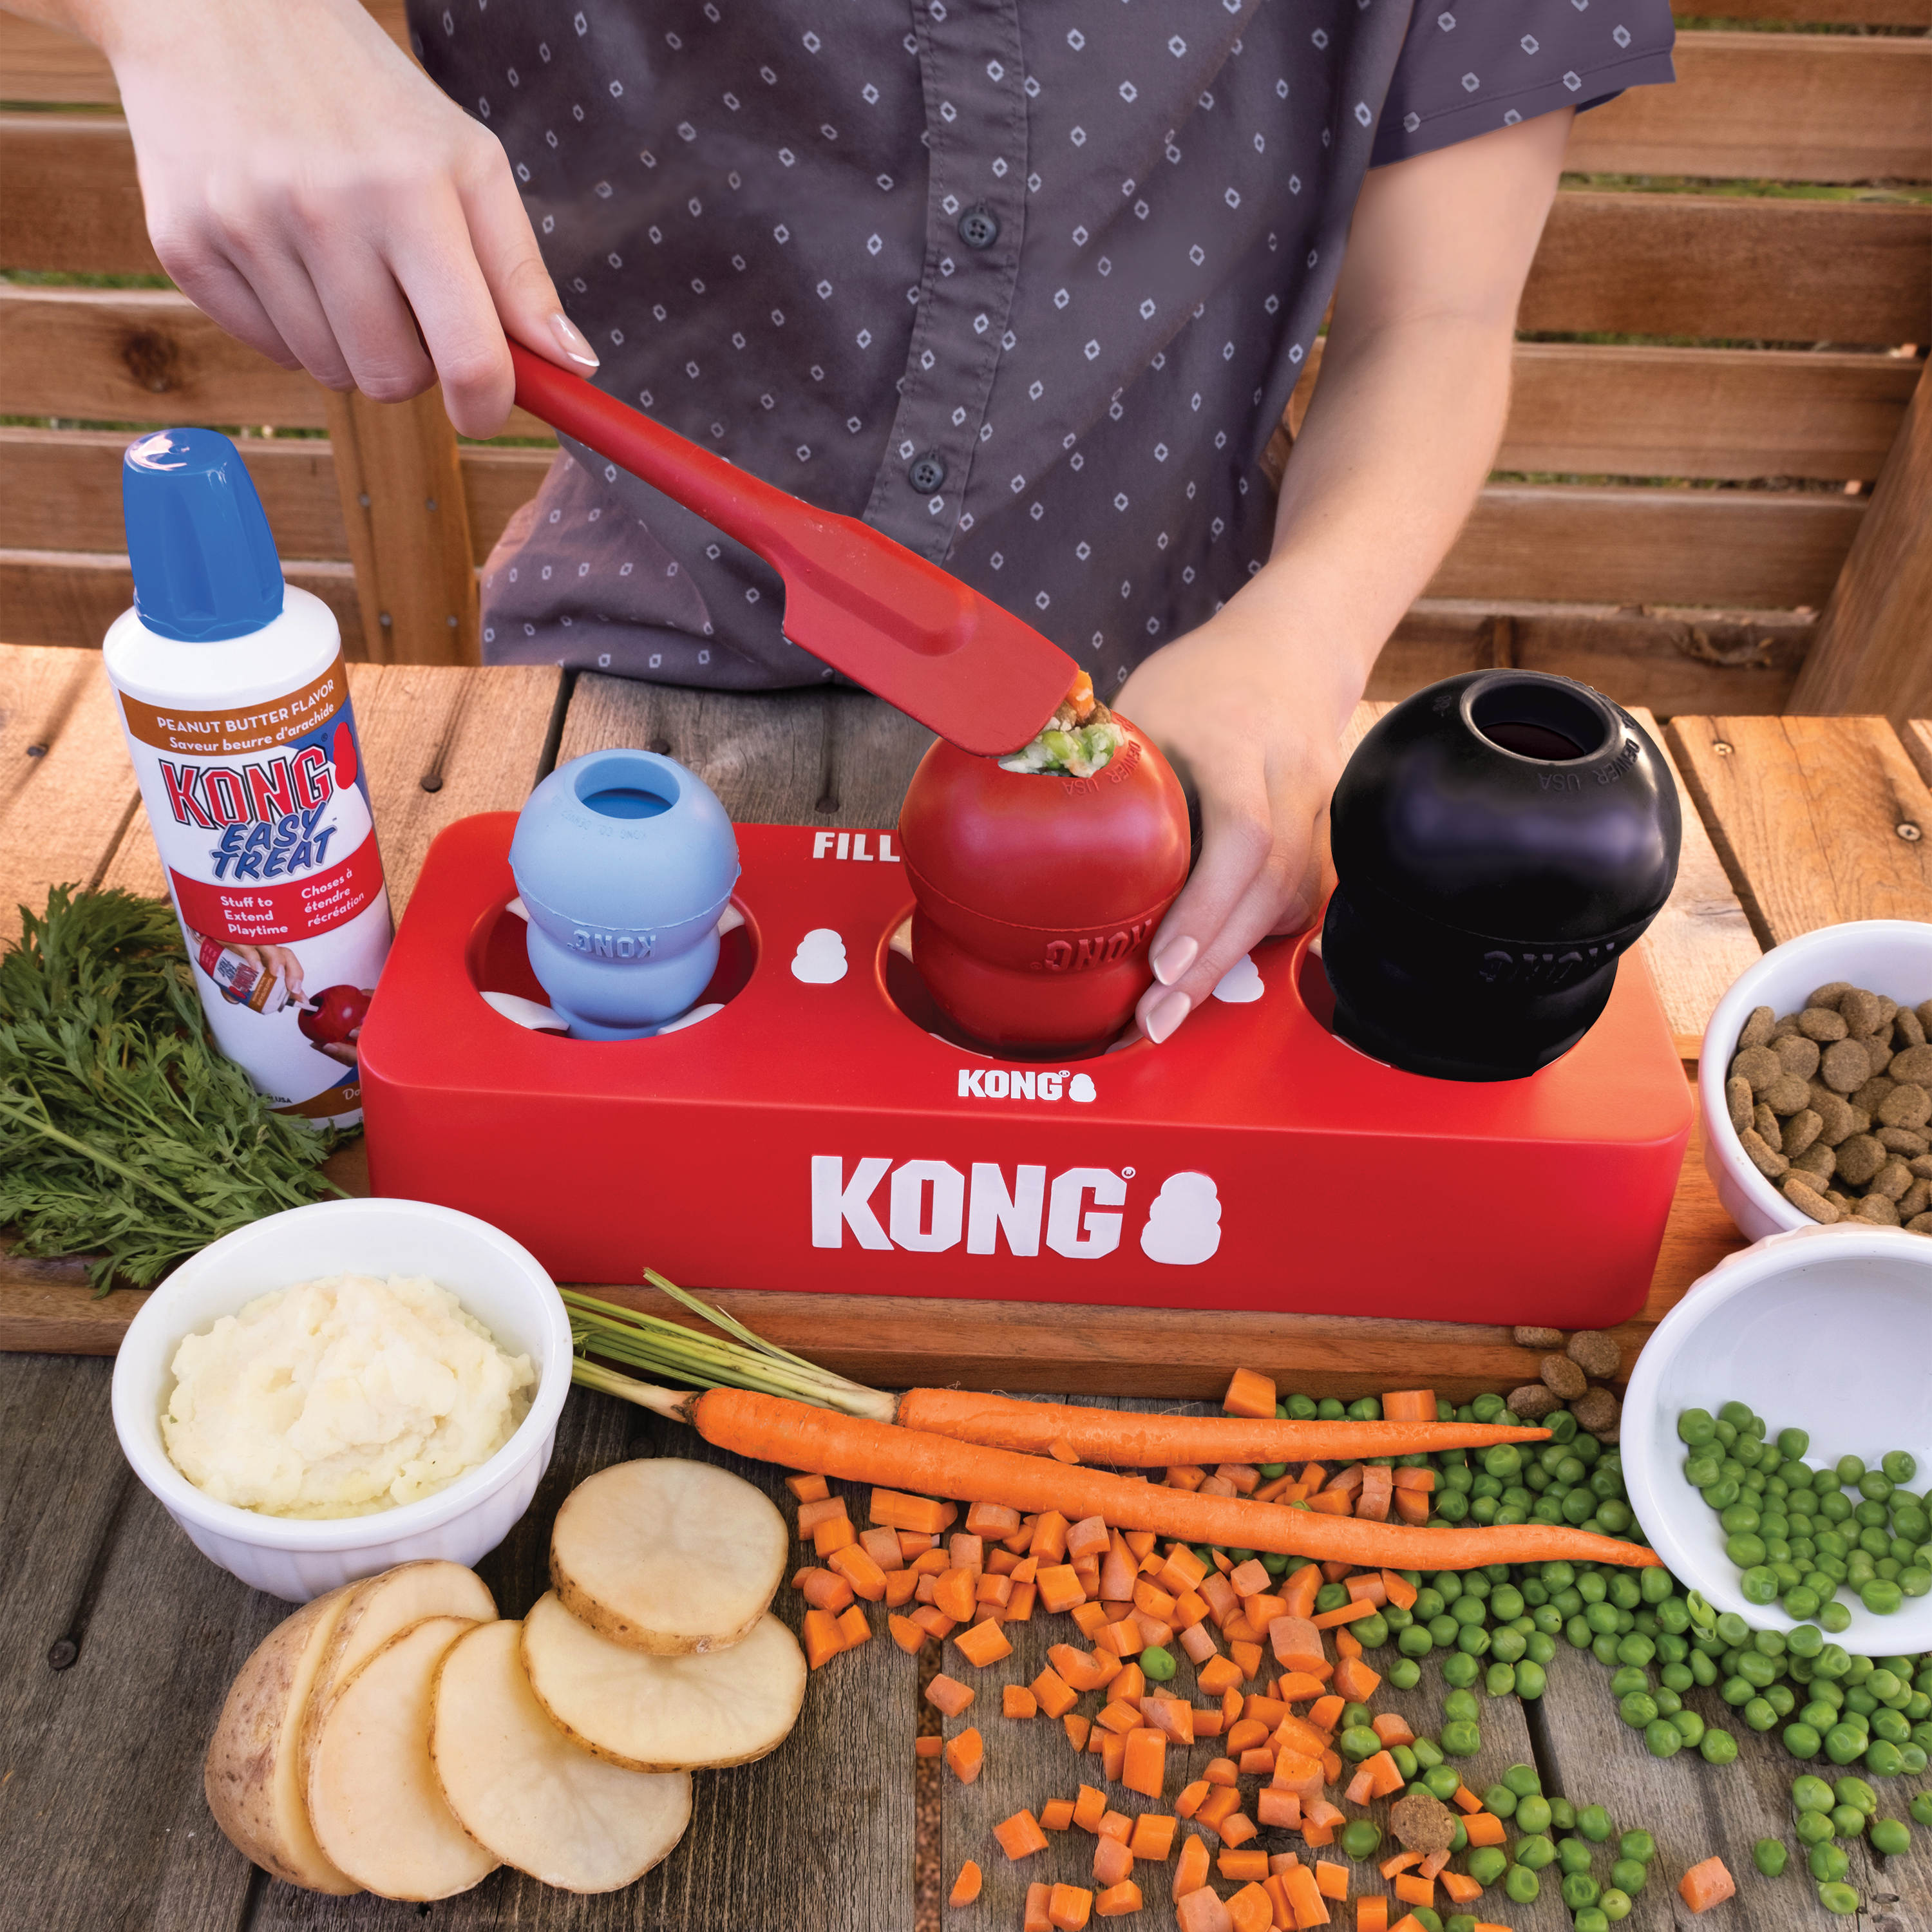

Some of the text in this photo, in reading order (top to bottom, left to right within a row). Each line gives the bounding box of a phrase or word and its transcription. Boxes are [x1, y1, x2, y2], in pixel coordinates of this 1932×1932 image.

[156, 679, 334, 734] PEANUT BUTTER FLAVOR
[169, 703, 334, 752] Saveur beurre d'arachide
[1105, 739, 1141, 784] DENVER
[1591, 737, 1640, 784] DENVER
[1062, 777, 1099, 796] USA
[1538, 773, 1581, 791] USA
[216, 800, 327, 855] EASY
[813, 832, 900, 862] FILL
[301, 868, 353, 898] Choses à
[220, 896, 273, 907] Stuff to
[224, 909, 274, 922] Extend
[304, 888, 350, 913] étendre
[308, 893, 365, 927] récréation
[228, 923, 289, 937] Playtime
